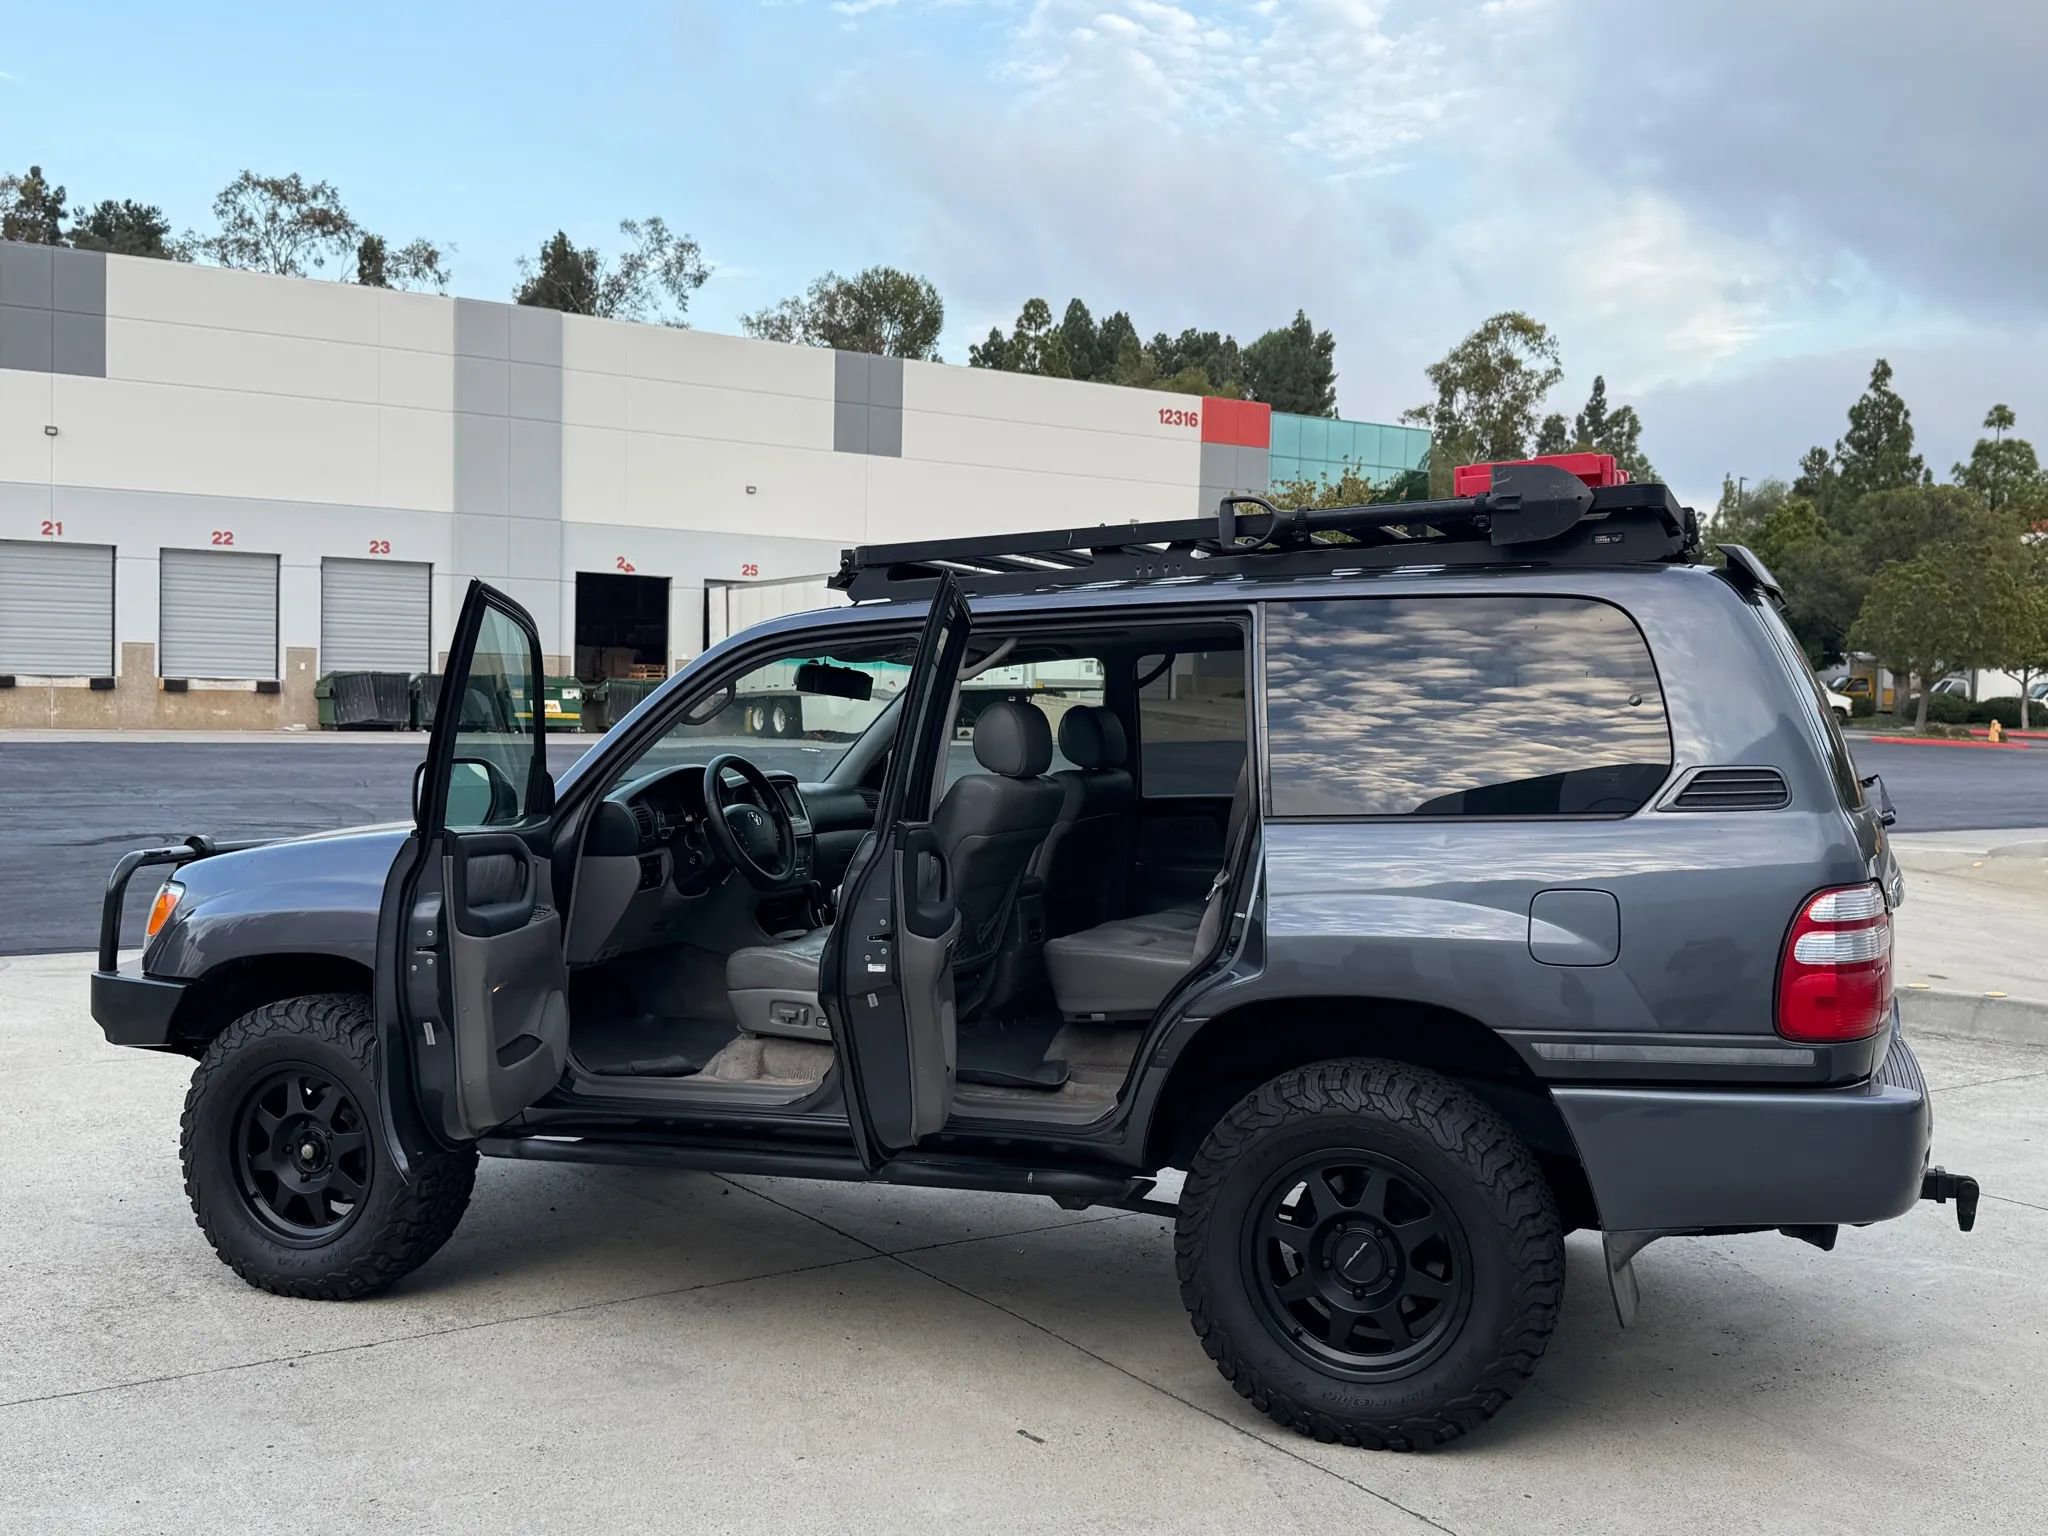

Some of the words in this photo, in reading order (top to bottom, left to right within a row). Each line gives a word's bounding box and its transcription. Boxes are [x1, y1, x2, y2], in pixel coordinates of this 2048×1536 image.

[1158, 408, 1198, 428] 12316
[41, 521, 62, 536] 21
[212, 531, 234, 545] 22
[369, 540, 391, 554] 23
[741, 563, 759, 577] 25
